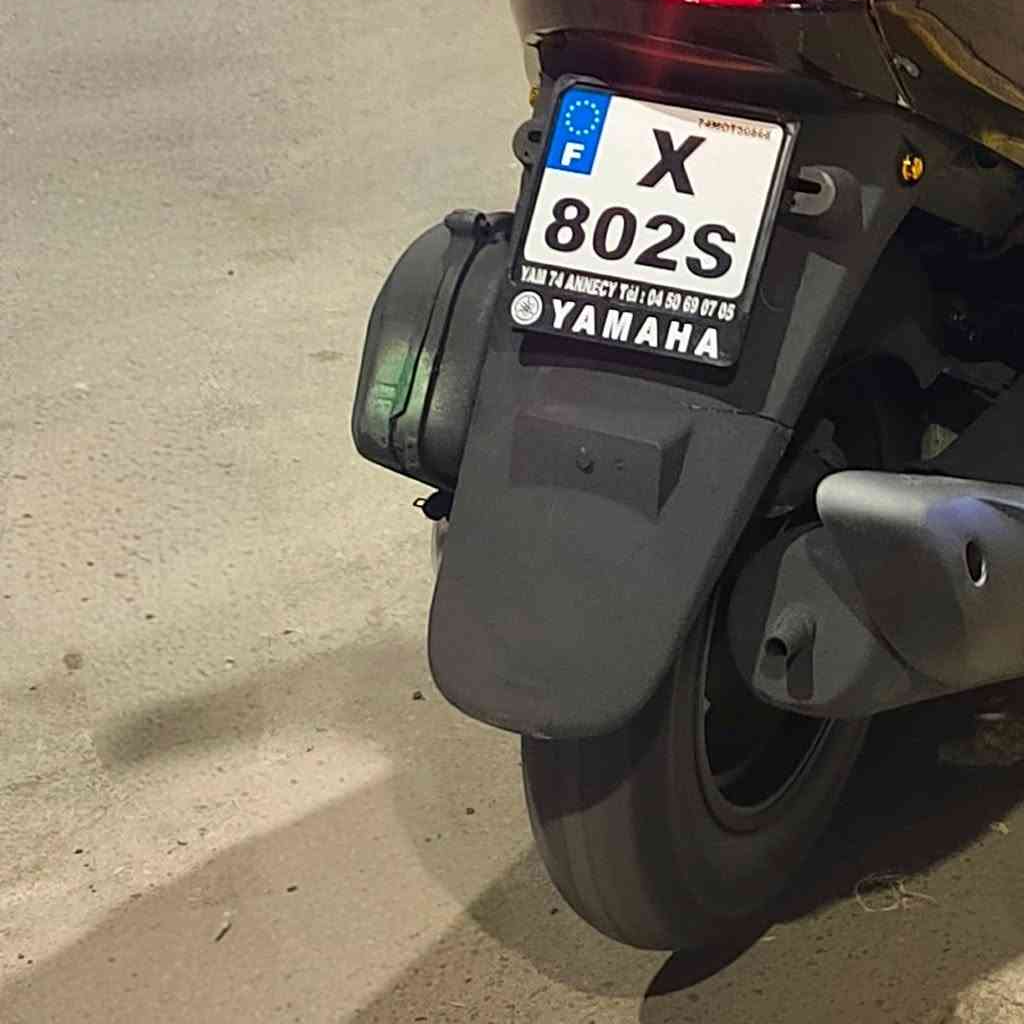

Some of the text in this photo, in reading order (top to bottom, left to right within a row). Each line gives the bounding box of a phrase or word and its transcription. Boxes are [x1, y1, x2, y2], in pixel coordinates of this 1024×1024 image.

[560, 142, 585, 166] F
[636, 128, 706, 196] X
[545, 197, 736, 278] 802S
[521, 265, 548, 285] YAM
[548, 270, 565, 289] 74
[564, 274, 618, 298] ANNECY
[646, 288, 664, 307] 04
[664, 291, 682, 311] 50
[682, 295, 700, 315] 69
[700, 298, 718, 317] 07
[717, 302, 736, 322] 05
[552, 298, 719, 360] YAMAHA
